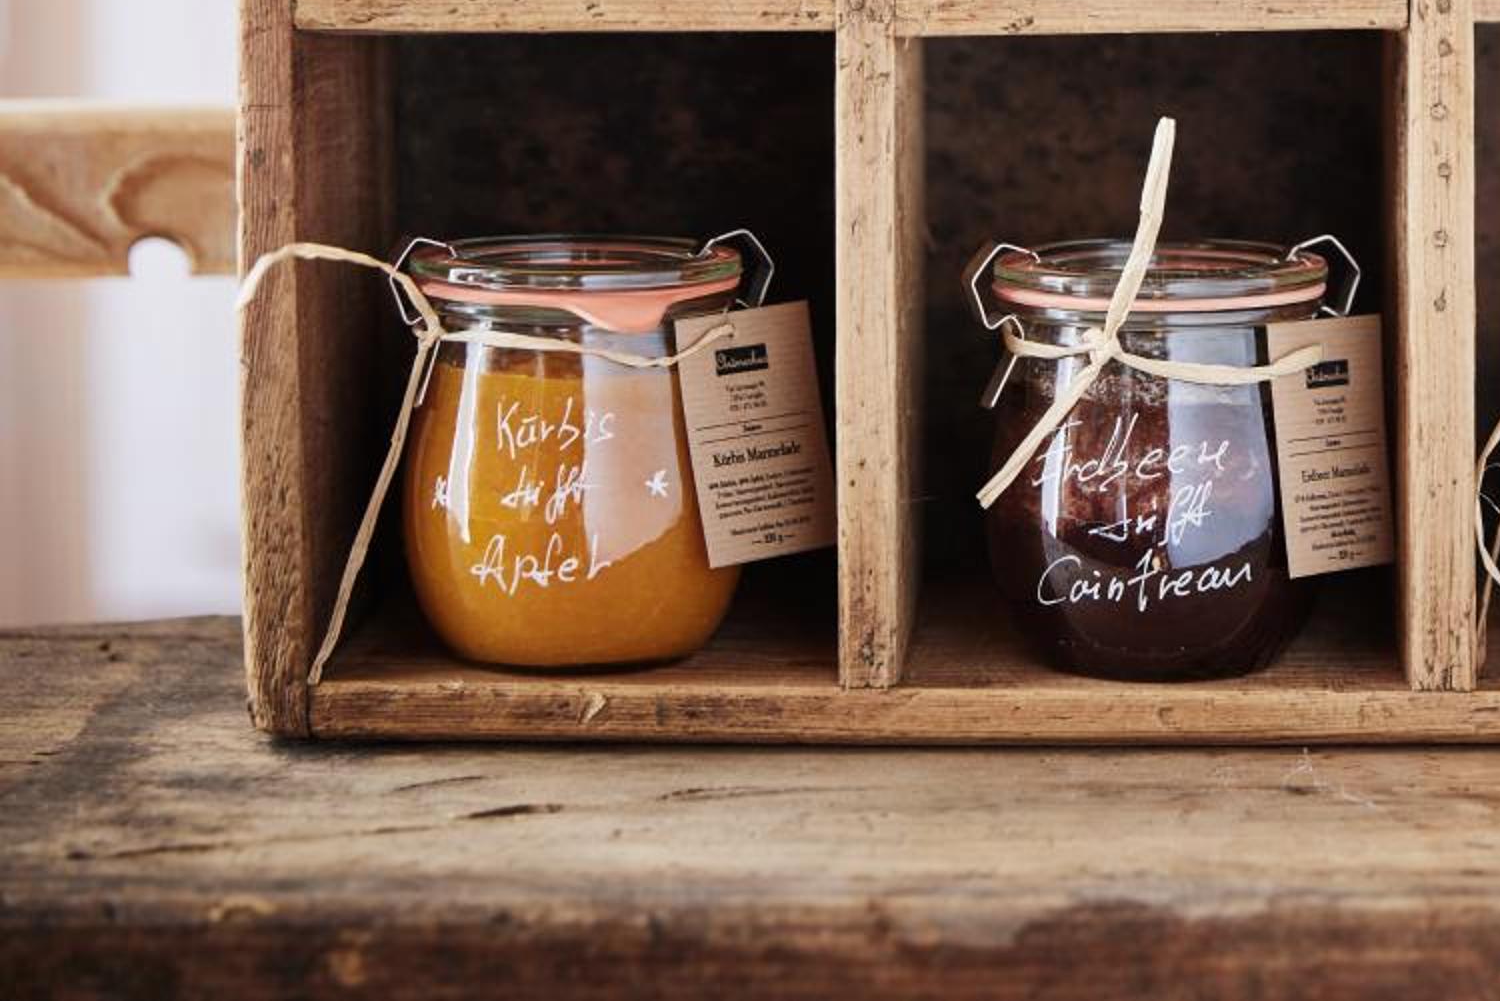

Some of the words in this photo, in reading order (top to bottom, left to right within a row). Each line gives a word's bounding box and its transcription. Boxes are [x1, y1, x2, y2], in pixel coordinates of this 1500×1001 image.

[498, 396, 615, 460] Kürbis
[470, 533, 611, 596] Apfel
[1038, 548, 1252, 613] Cointreau
